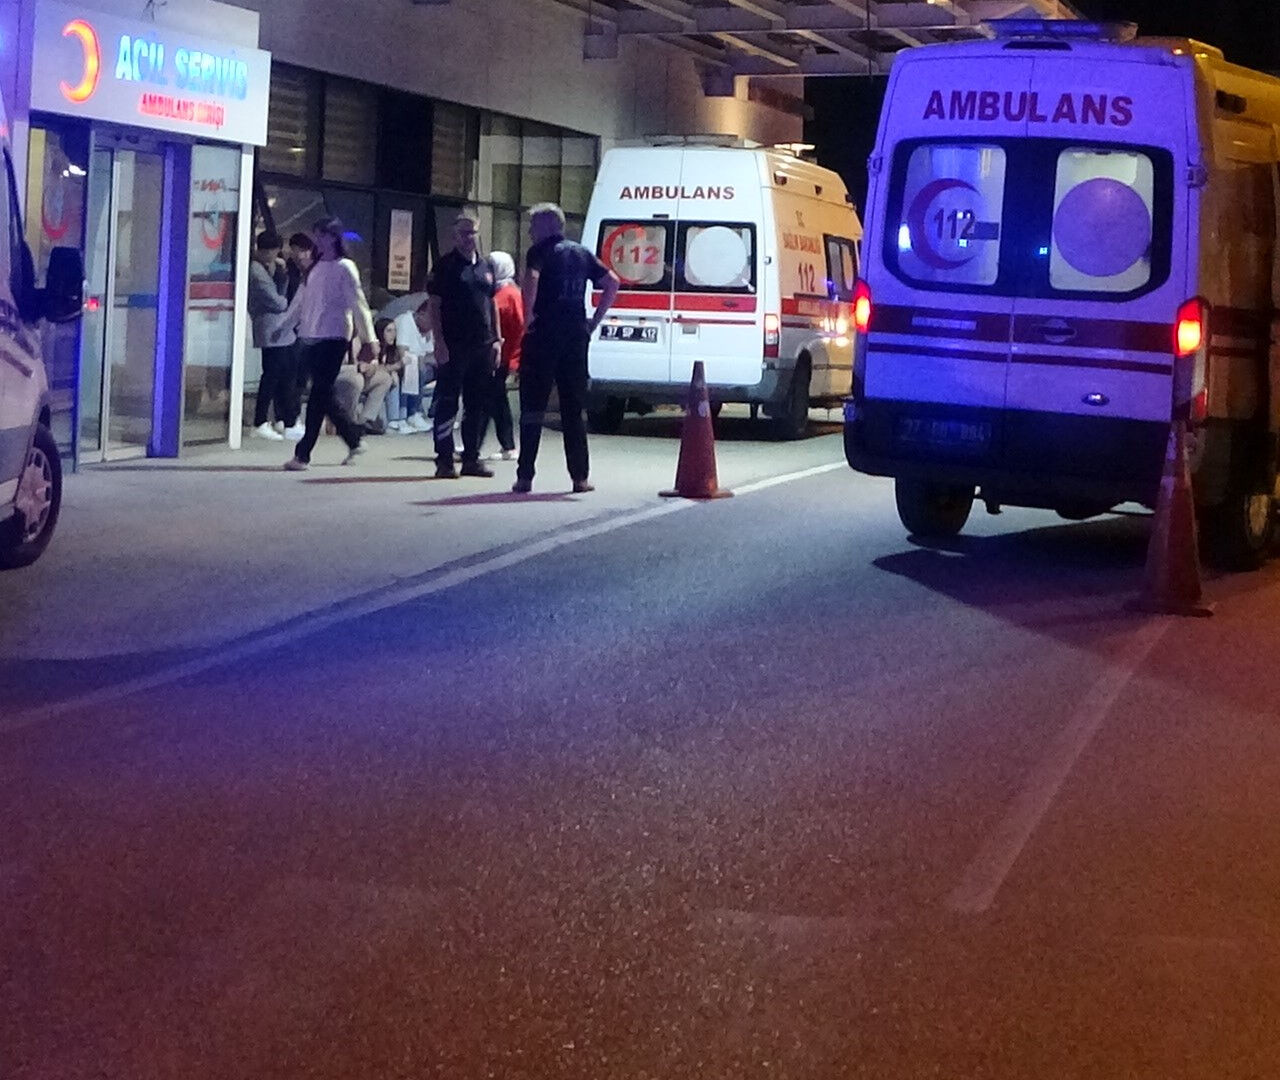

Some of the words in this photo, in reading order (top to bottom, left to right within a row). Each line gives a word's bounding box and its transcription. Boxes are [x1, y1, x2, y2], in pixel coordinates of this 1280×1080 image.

[923, 89, 1134, 128] AMBULANS
[619, 185, 736, 201] AMBULANS
[933, 208, 976, 240] 112
[613, 245, 660, 265] 112
[797, 261, 816, 293] 112
